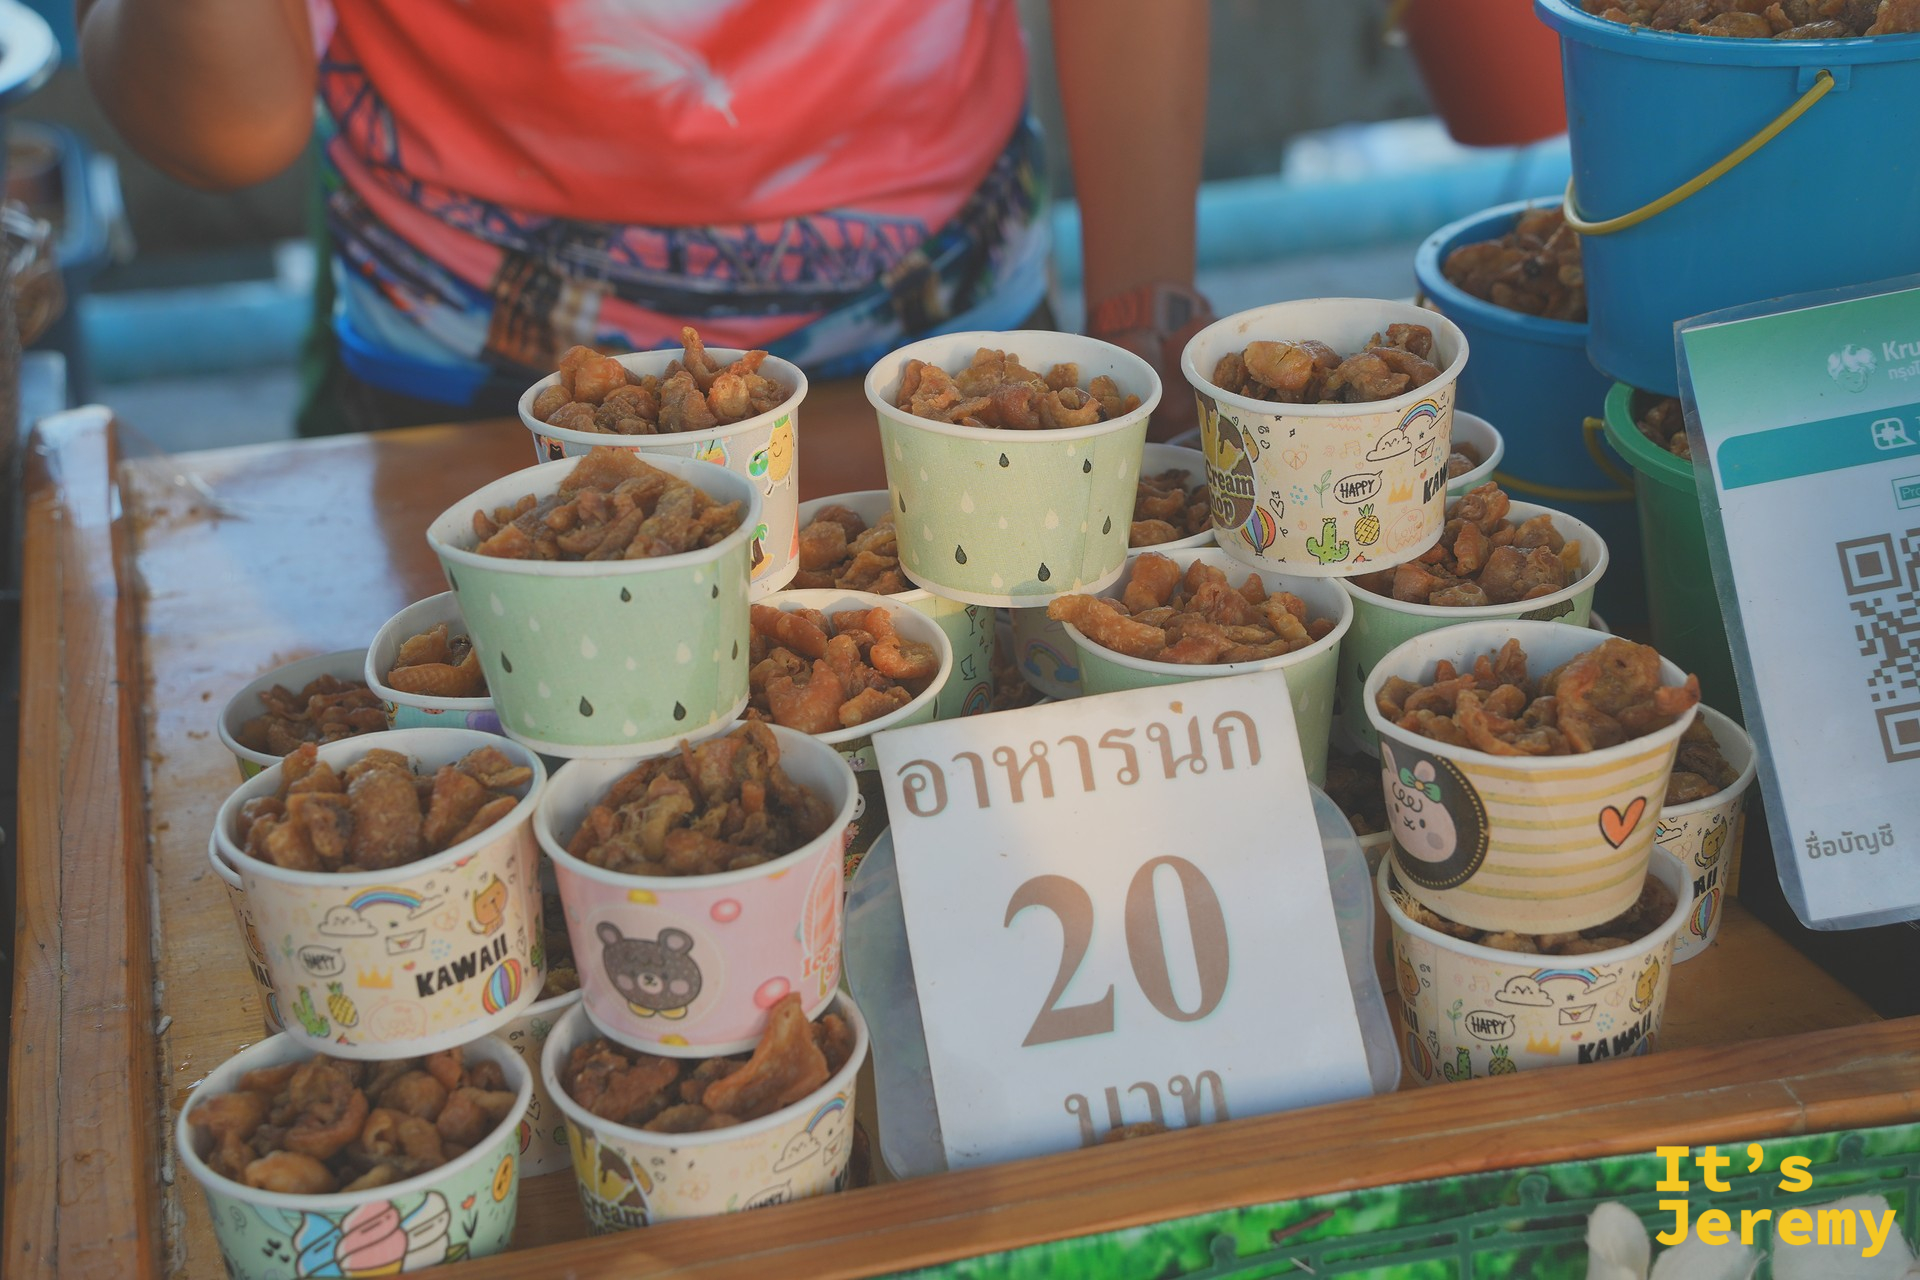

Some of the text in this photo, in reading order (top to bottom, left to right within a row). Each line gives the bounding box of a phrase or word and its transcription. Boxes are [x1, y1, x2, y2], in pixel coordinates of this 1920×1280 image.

[1339, 478, 1375, 499] HAPPY
[897, 709, 1262, 818] อาหารนก
[1805, 823, 1894, 859] ชื่อบัญชี
[416, 934, 509, 998] KAWAII
[1003, 854, 1230, 1048] 20
[1471, 1016, 1507, 1035] HAPPY
[1578, 1009, 1652, 1064] KAWAII
[1064, 1070, 1230, 1149] บาท
